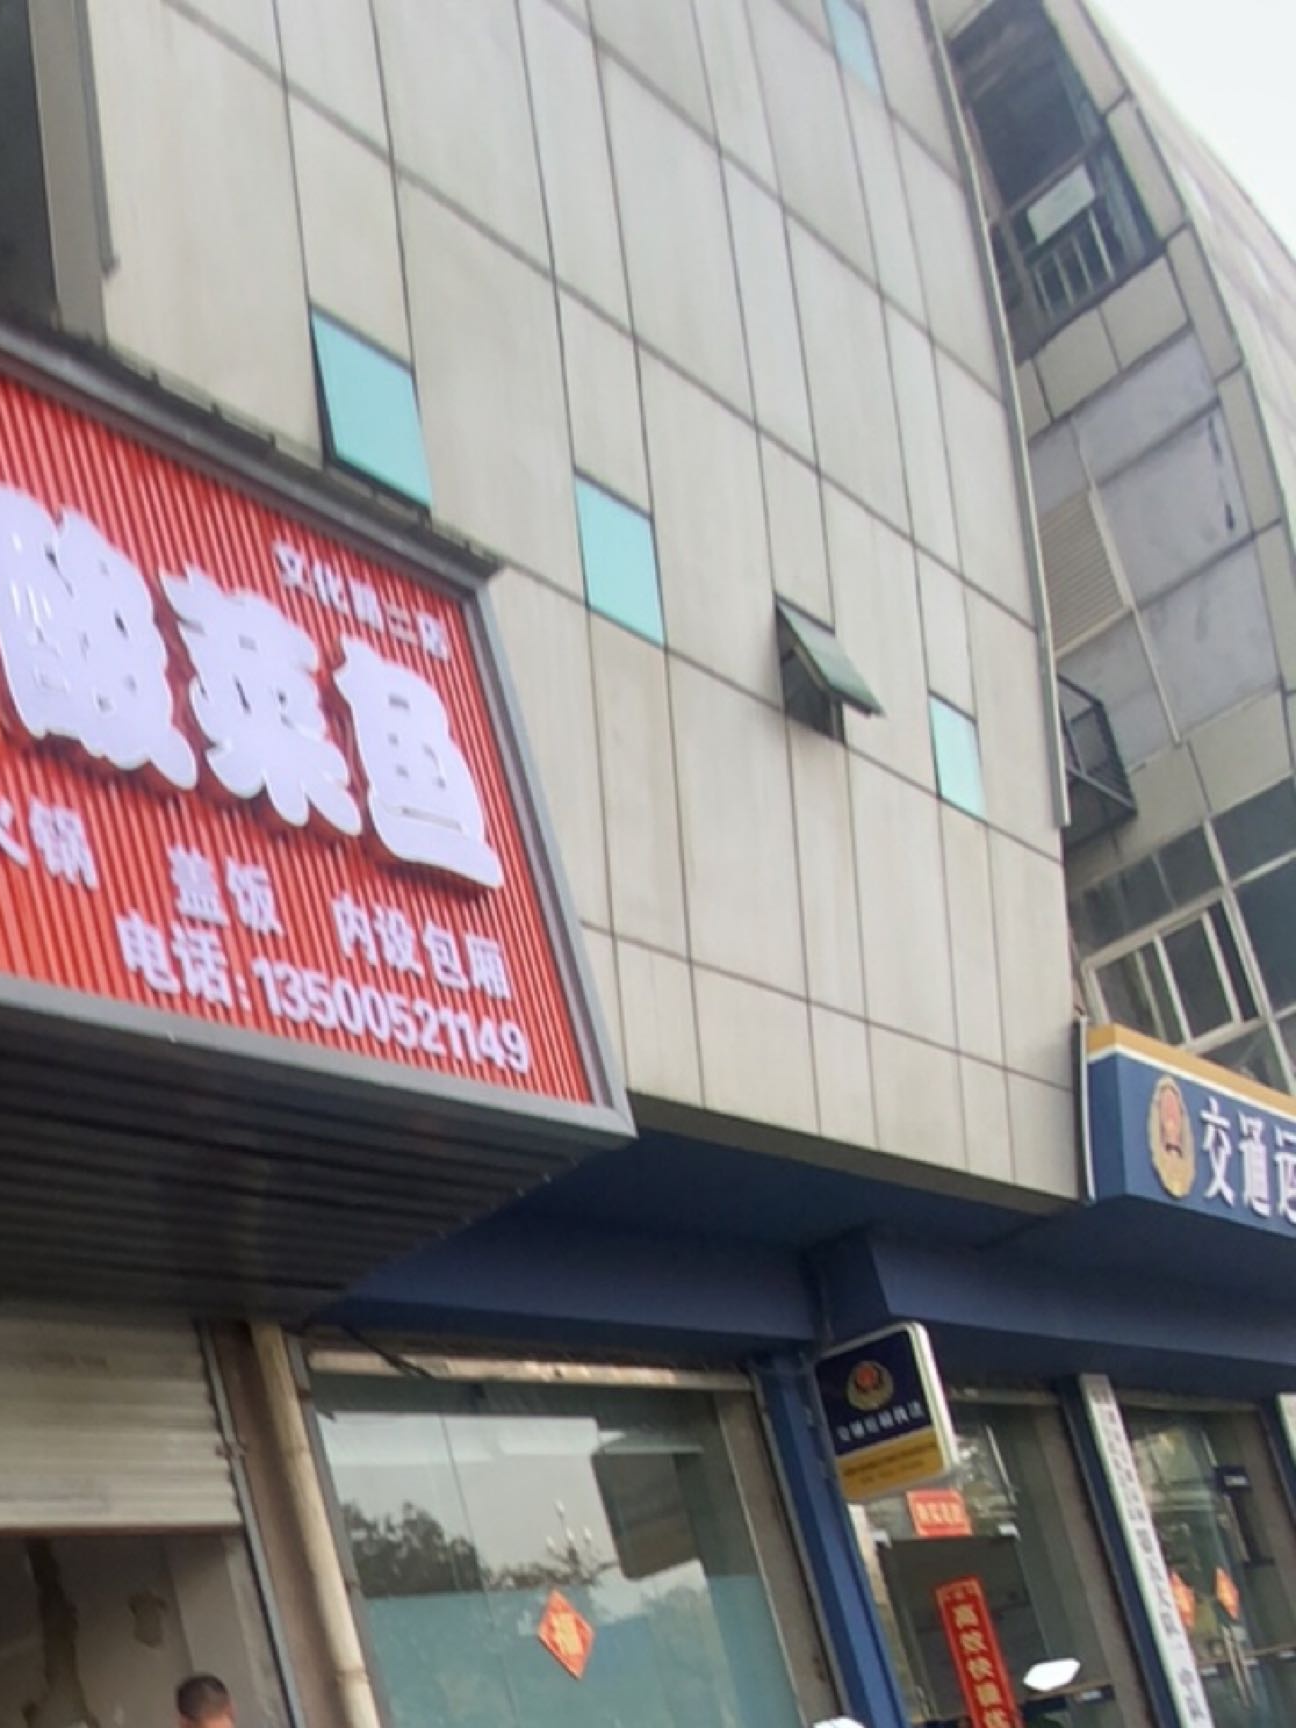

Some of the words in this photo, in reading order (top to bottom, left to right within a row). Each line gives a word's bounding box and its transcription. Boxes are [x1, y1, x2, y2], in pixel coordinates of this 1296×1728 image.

[168, 844, 283, 937] 盖饭
[331, 891, 513, 1001] 内设包厢
